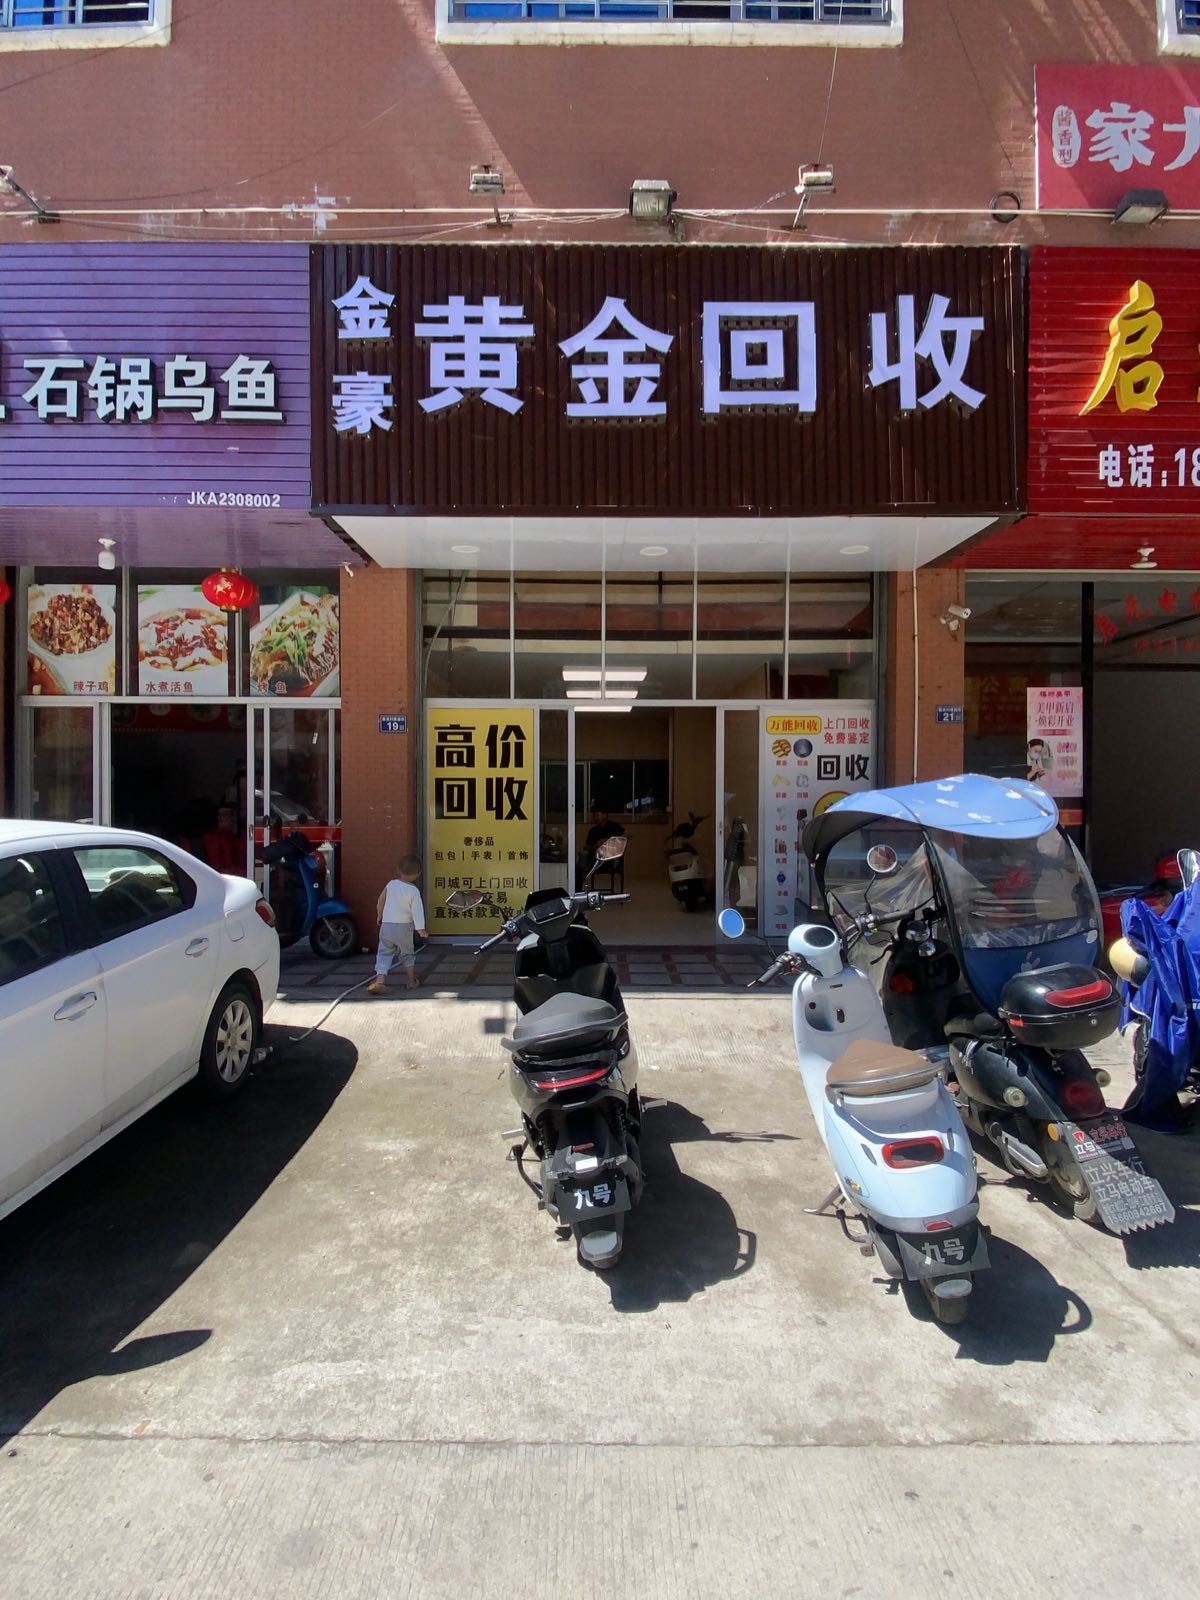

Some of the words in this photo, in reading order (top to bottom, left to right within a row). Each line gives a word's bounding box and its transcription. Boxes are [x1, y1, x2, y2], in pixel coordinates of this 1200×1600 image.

[331, 275, 395, 435] 金豪
[414, 293, 985, 415] 黄金回收
[22, 354, 282, 422] 石锅乌鱼
[187, 491, 281, 507] JKA2308002
[73, 680, 108, 692] 辣子鸡
[145, 680, 193, 692] 水煮活鱼
[771, 719, 818, 731] 万能回收
[824, 717, 870, 730] 上门回收
[434, 724, 527, 768] 高价
[824, 731, 870, 745] 免费鉴定
[816, 754, 870, 781] 回收
[434, 777, 529, 820] 回收
[463, 836, 494, 846] 奢侈品
[434, 877, 528, 889] 同城可上门回收
[574, 1183, 611, 1209] 九号
[1095, 1175, 1155, 1201] 立马电动车
[921, 1238, 964, 1265] 九号
